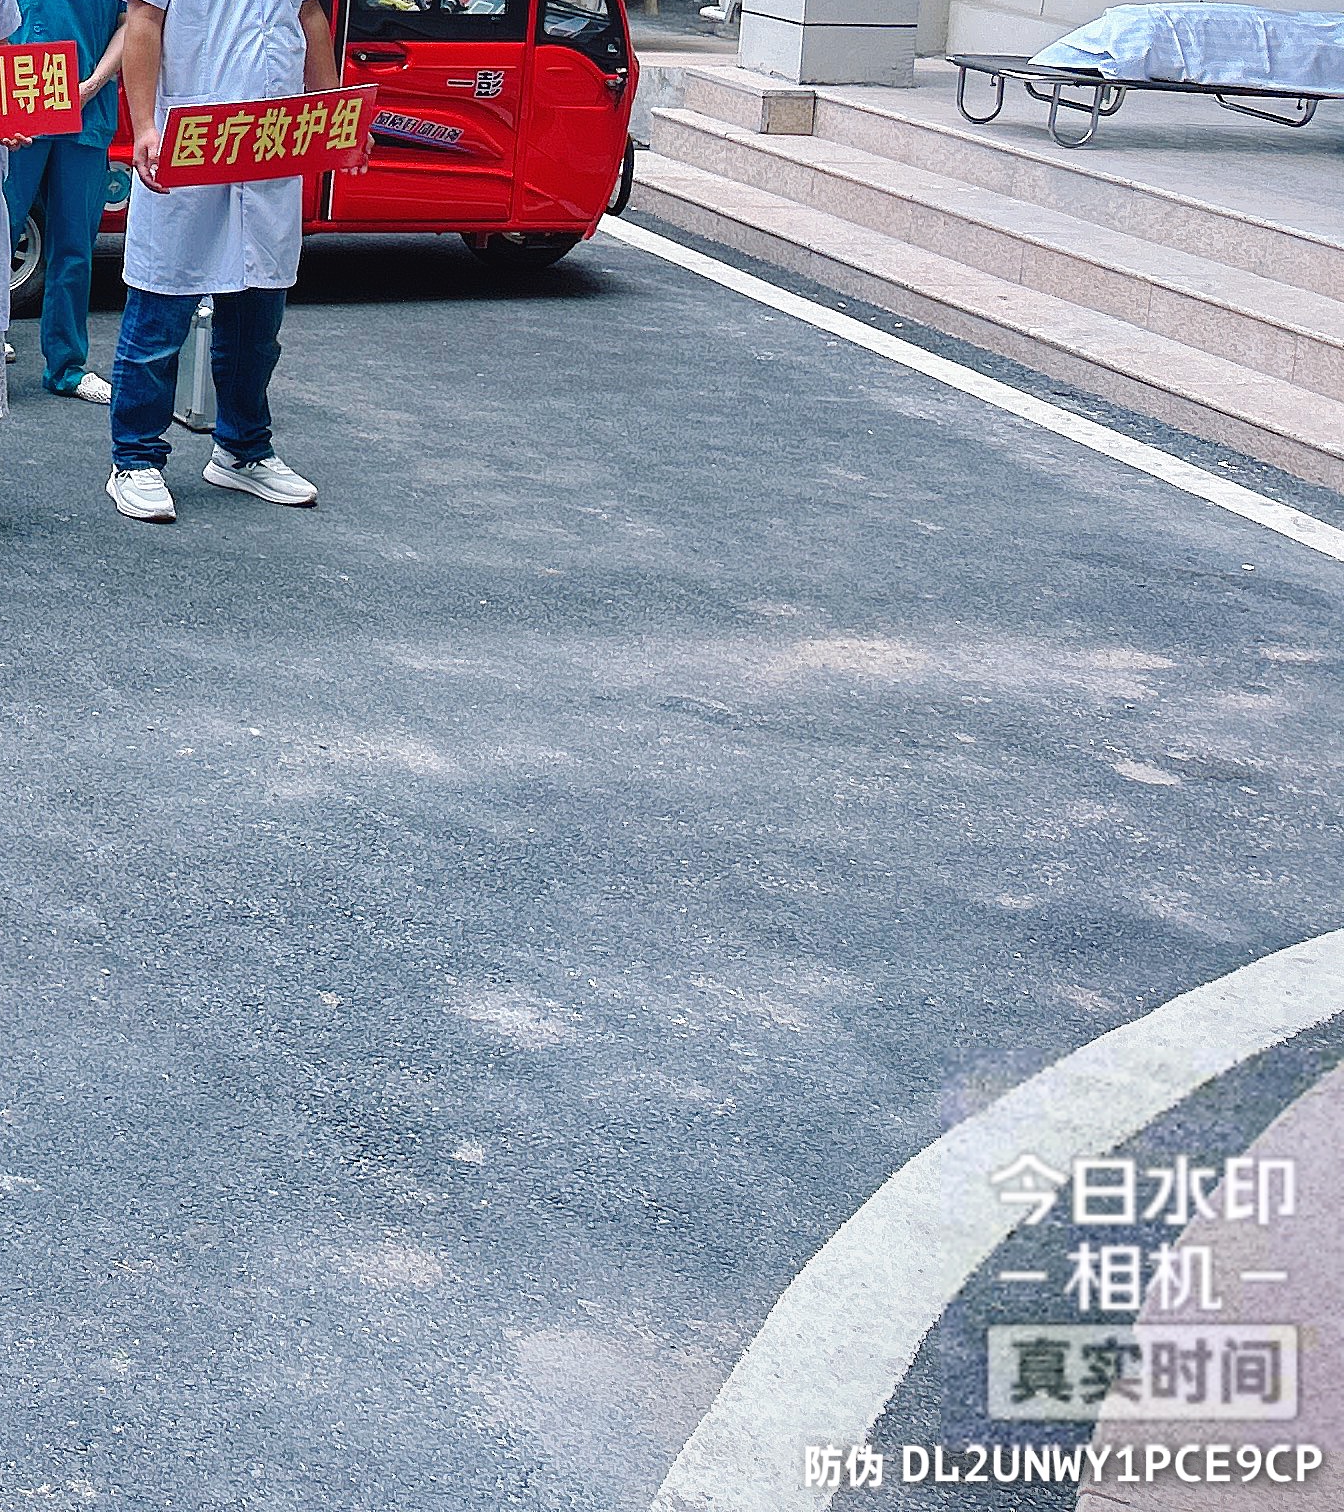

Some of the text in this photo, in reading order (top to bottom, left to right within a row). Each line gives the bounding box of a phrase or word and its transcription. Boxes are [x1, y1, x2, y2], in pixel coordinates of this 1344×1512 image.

[170, 97, 363, 167] 医疗救护组
